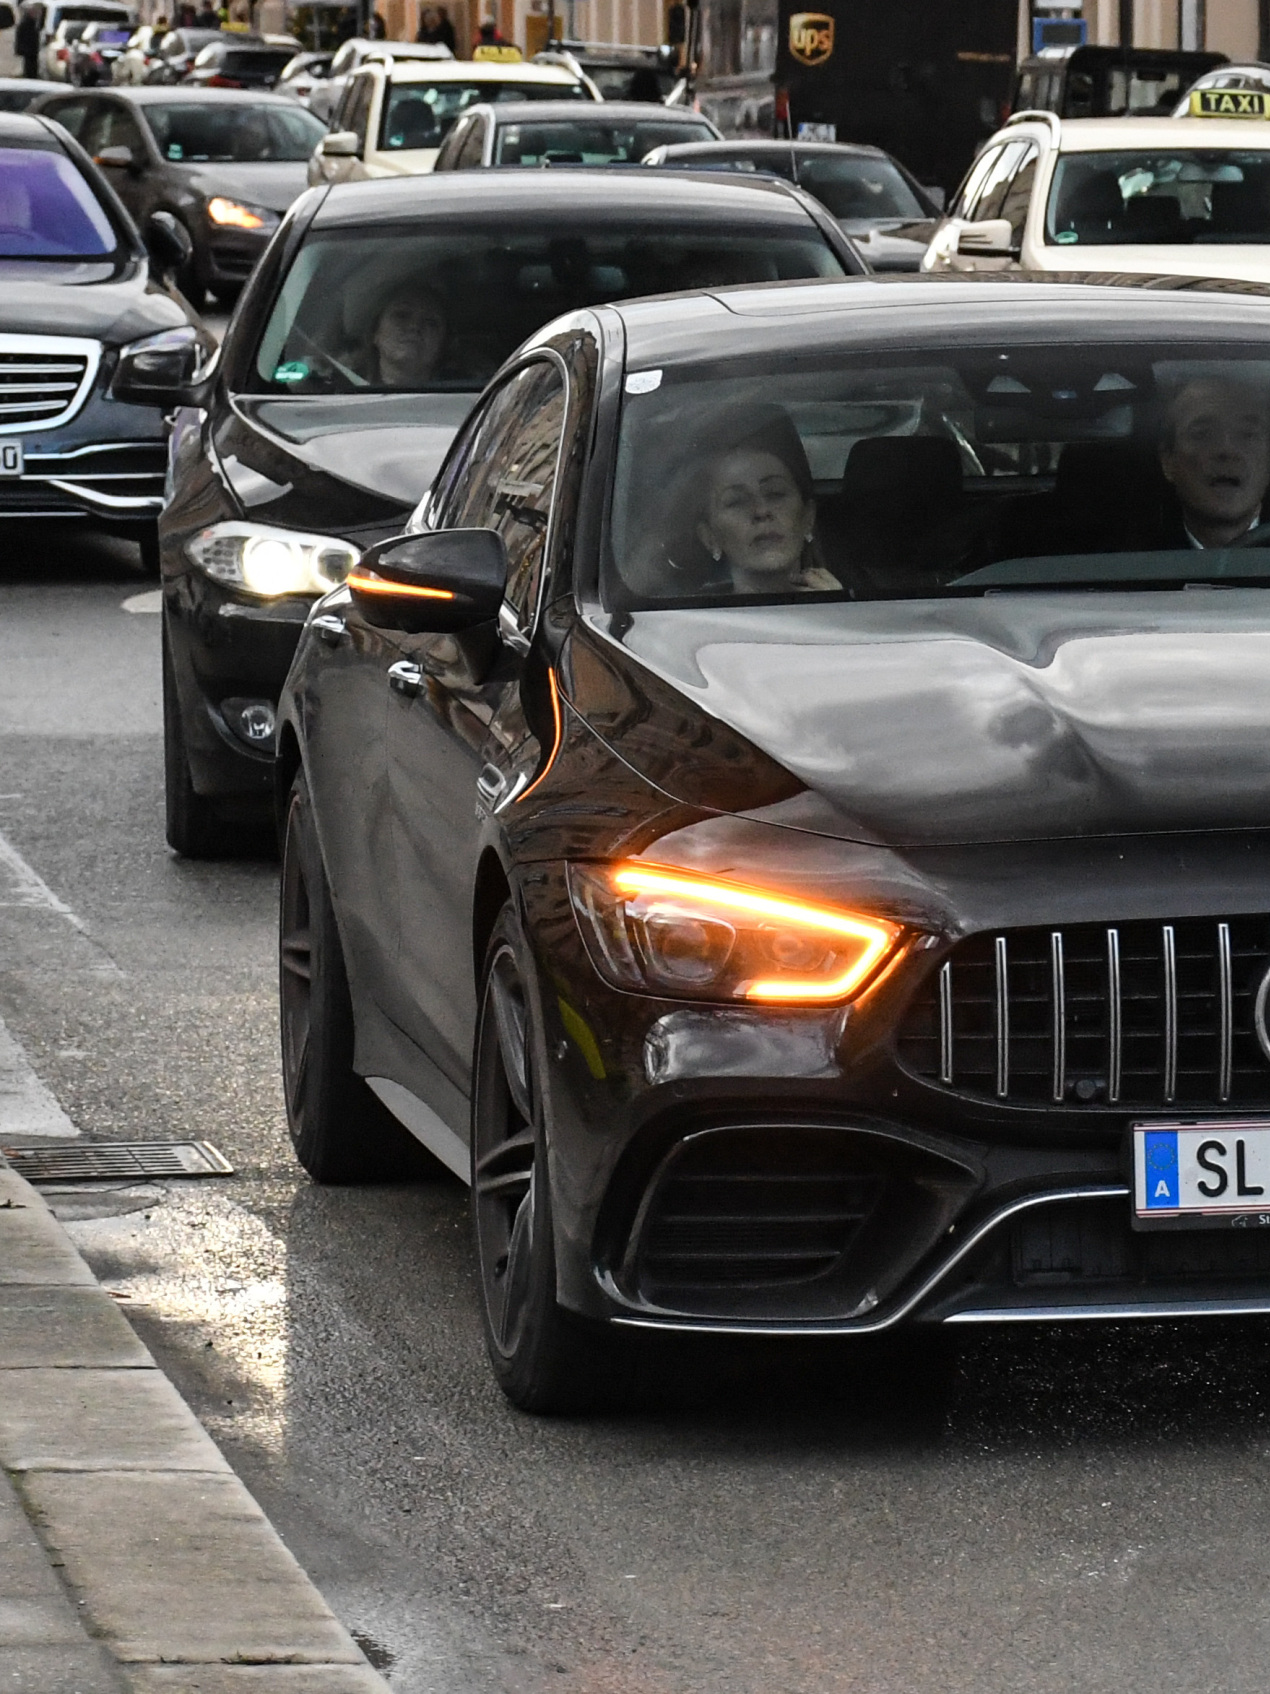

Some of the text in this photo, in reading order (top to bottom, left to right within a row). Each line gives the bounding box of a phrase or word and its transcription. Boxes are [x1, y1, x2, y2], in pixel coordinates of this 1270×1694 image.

[794, 28, 830, 56] ups
[1206, 93, 1260, 113] TAXI
[1196, 1139, 1264, 1198] SL
[1154, 1180, 1170, 1198] A
